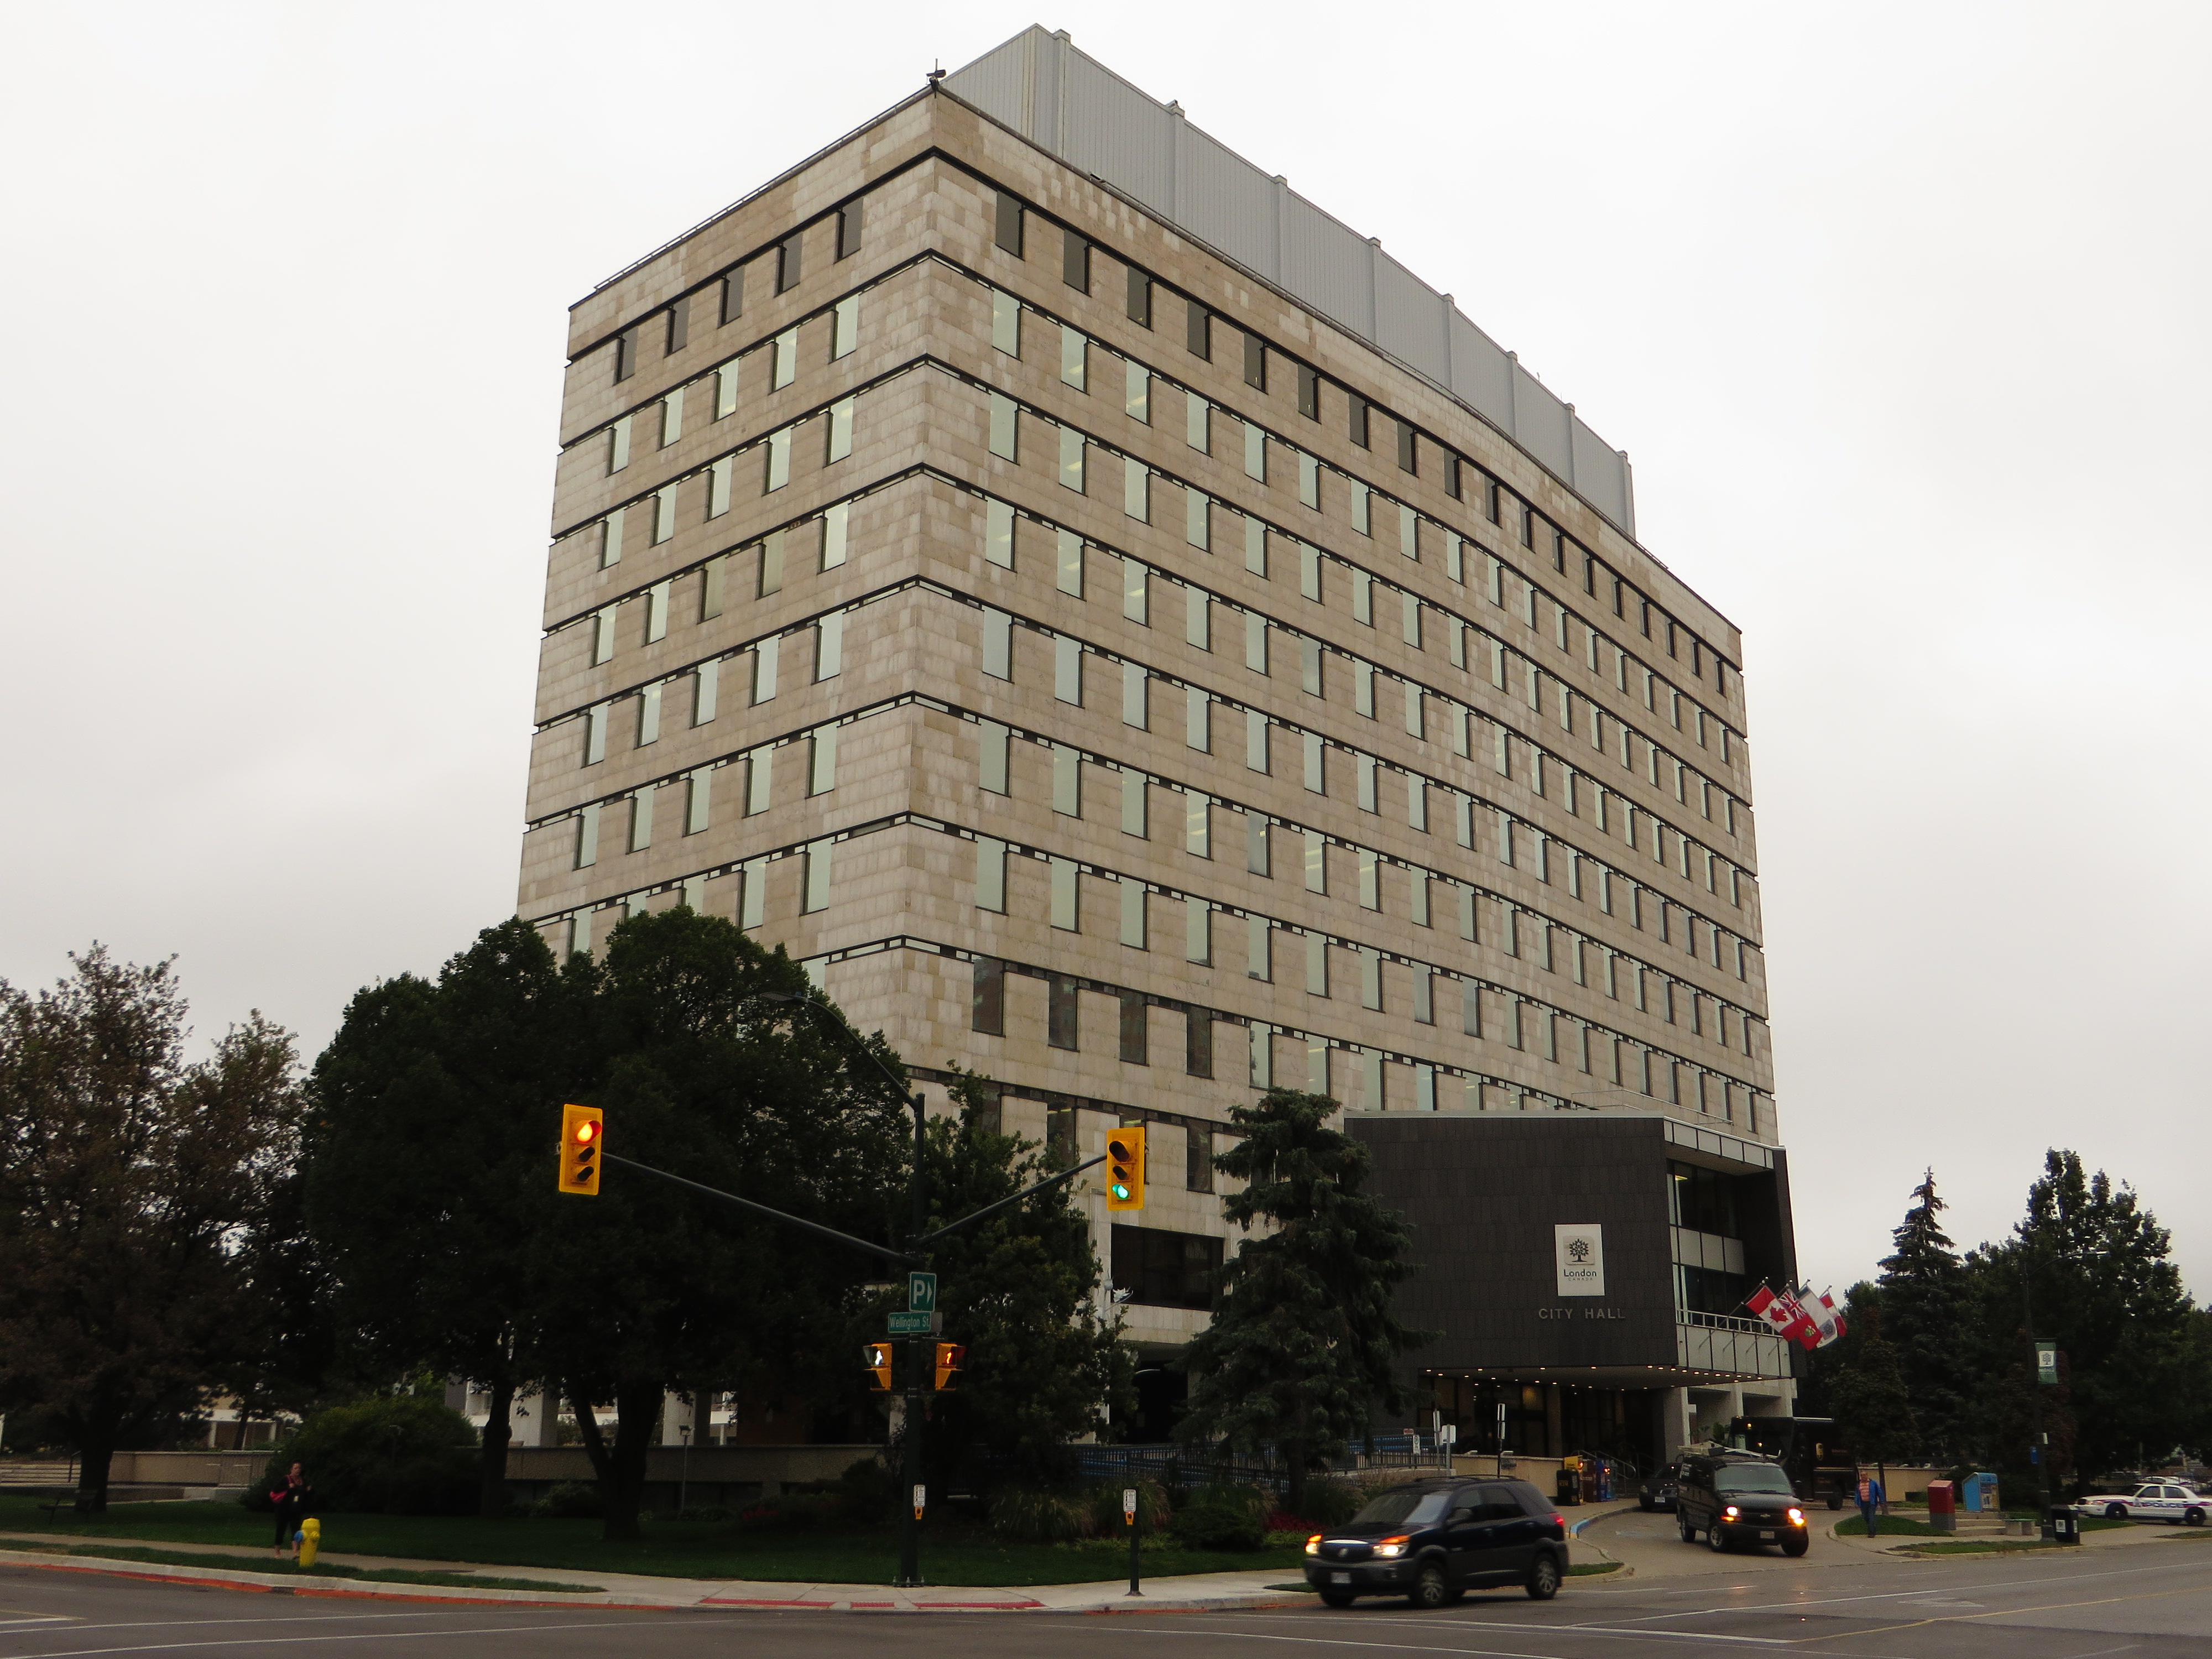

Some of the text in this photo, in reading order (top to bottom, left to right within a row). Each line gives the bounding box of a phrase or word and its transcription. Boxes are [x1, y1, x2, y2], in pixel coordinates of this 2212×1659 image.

[1564, 1269, 1597, 1277] London
[914, 1280, 926, 1304] P
[1538, 1308, 1626, 1319] CITY HALL
[890, 1317, 920, 1331] Wellington
